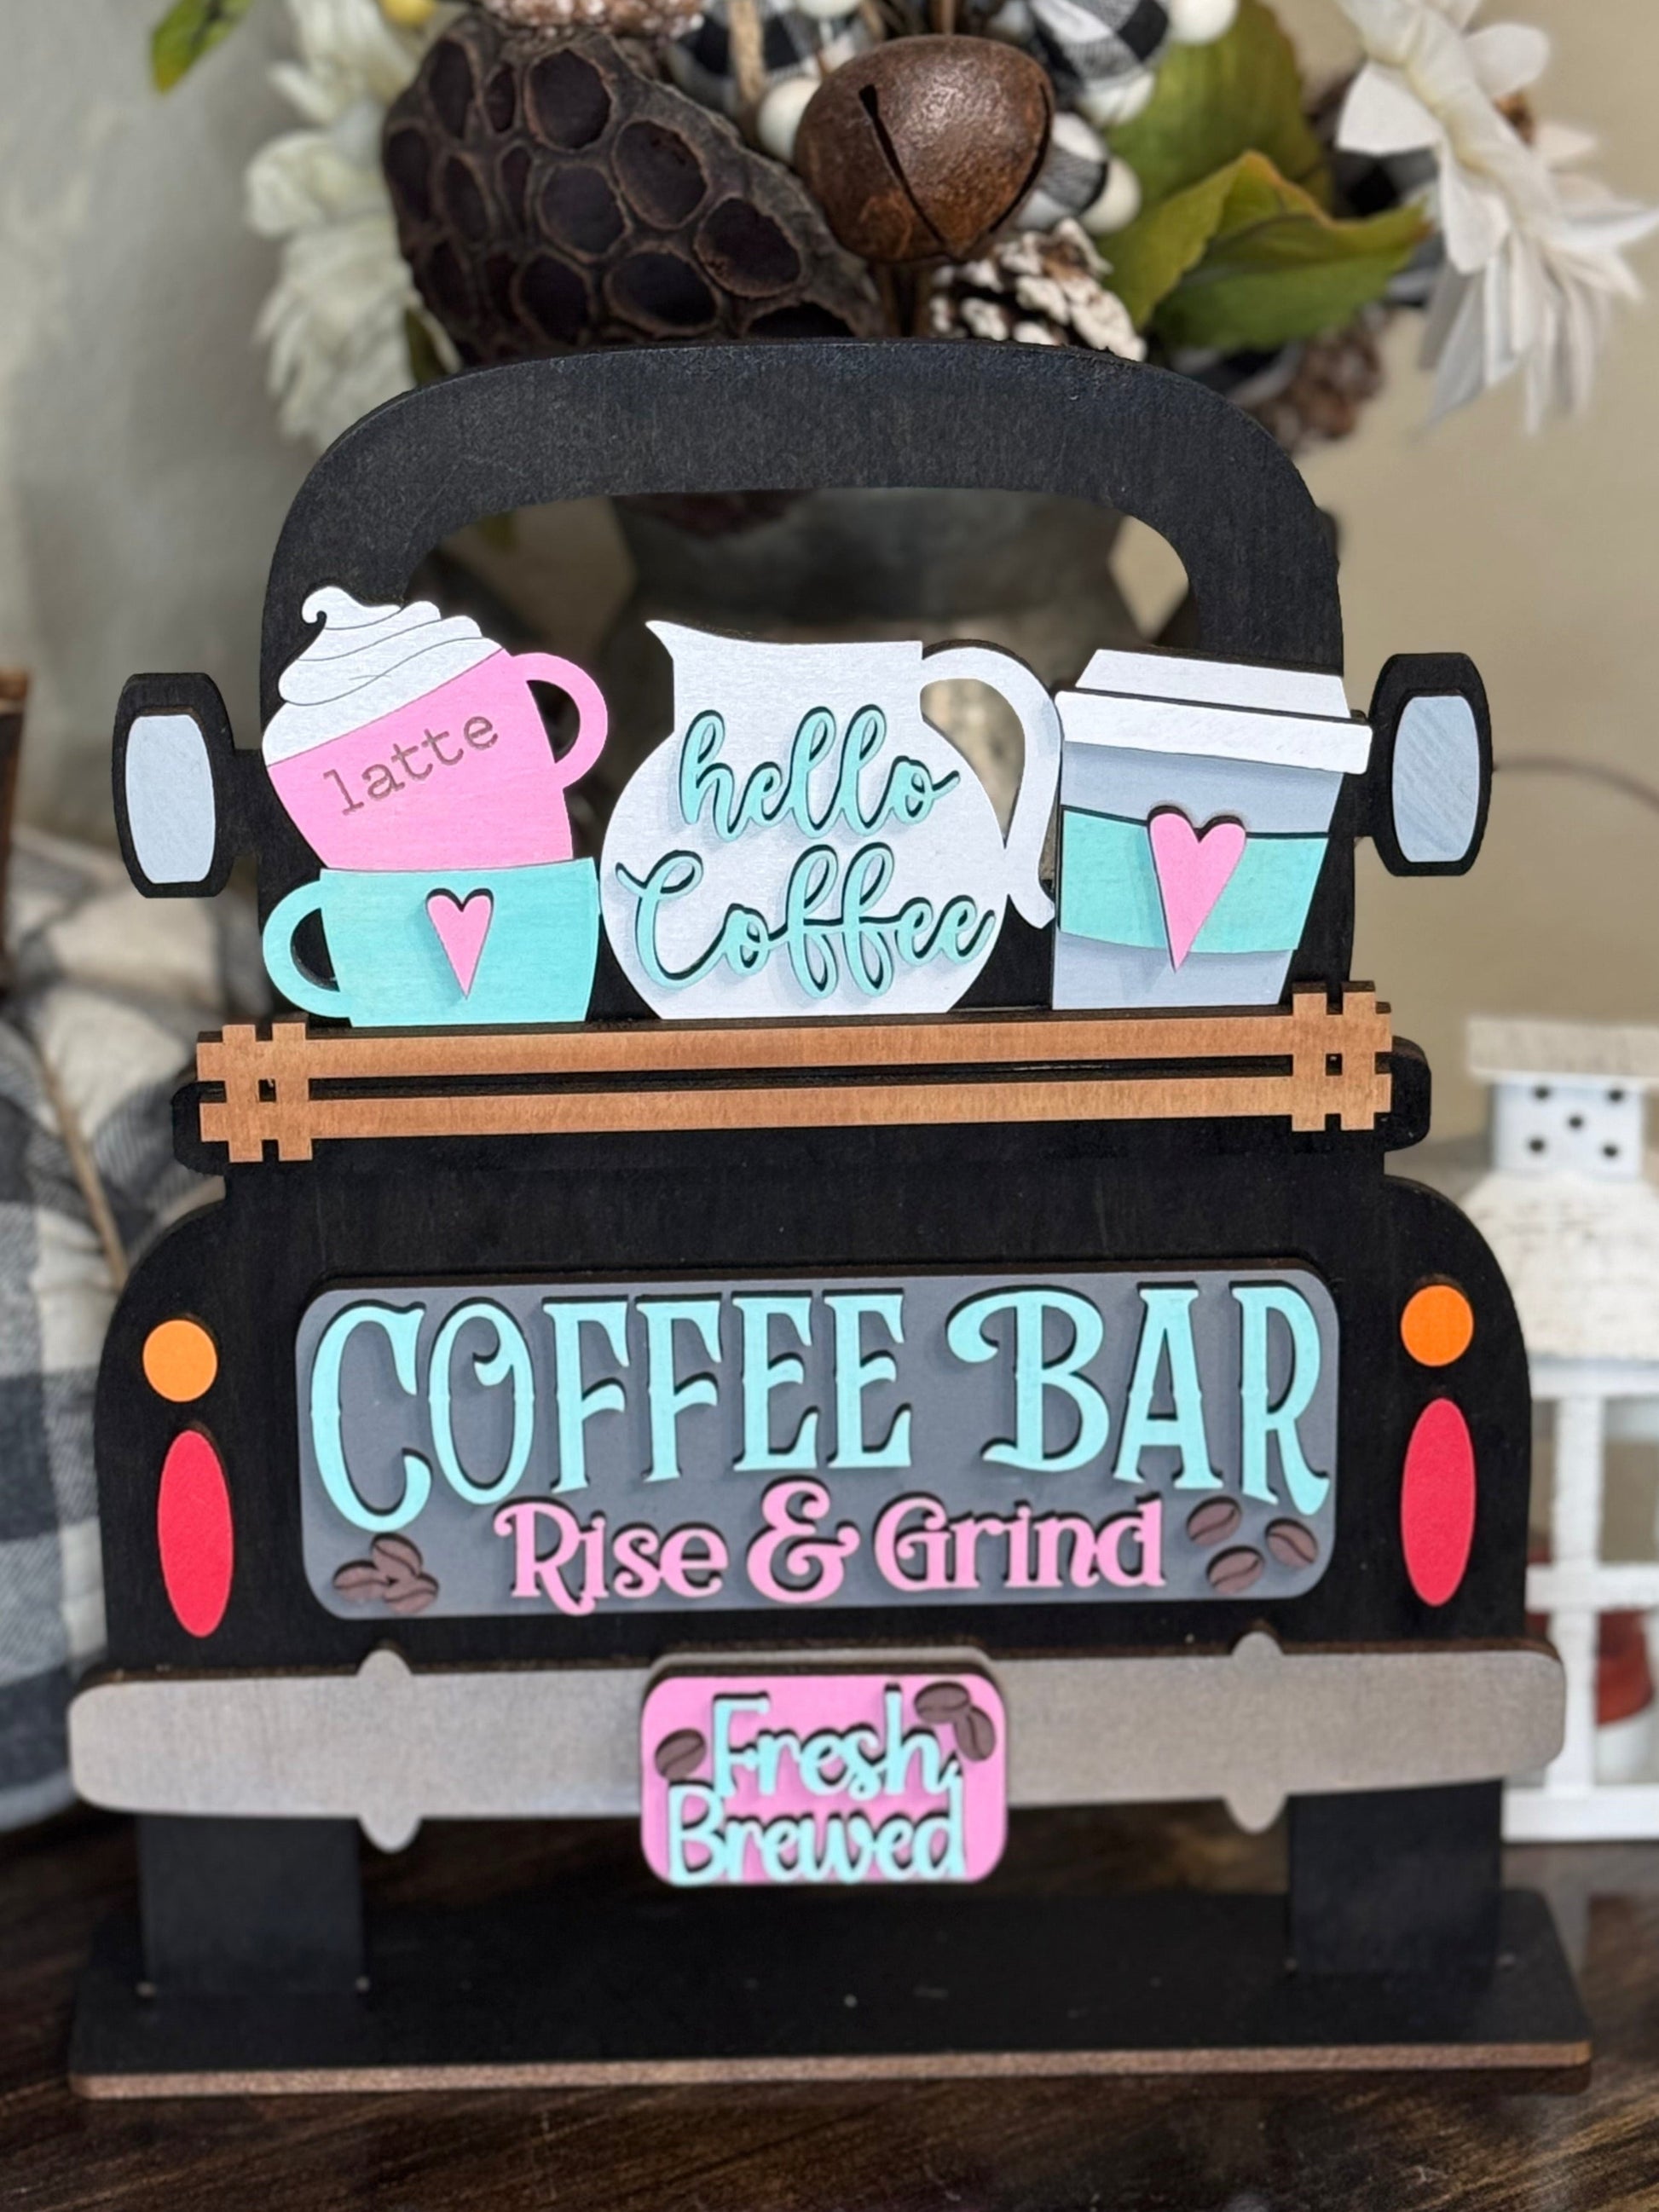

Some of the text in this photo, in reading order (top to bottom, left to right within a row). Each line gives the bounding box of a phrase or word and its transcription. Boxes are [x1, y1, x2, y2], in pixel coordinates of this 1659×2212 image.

[323, 714, 500, 816] latte
[680, 706, 960, 842] hello
[615, 844, 997, 1000] Coffee
[310, 1282, 1331, 1533] COFFEE BAR
[494, 1477, 1167, 1617] Rise & Grind
[713, 1686, 960, 1800] Fresh
[668, 1770, 966, 1886] Brewed
